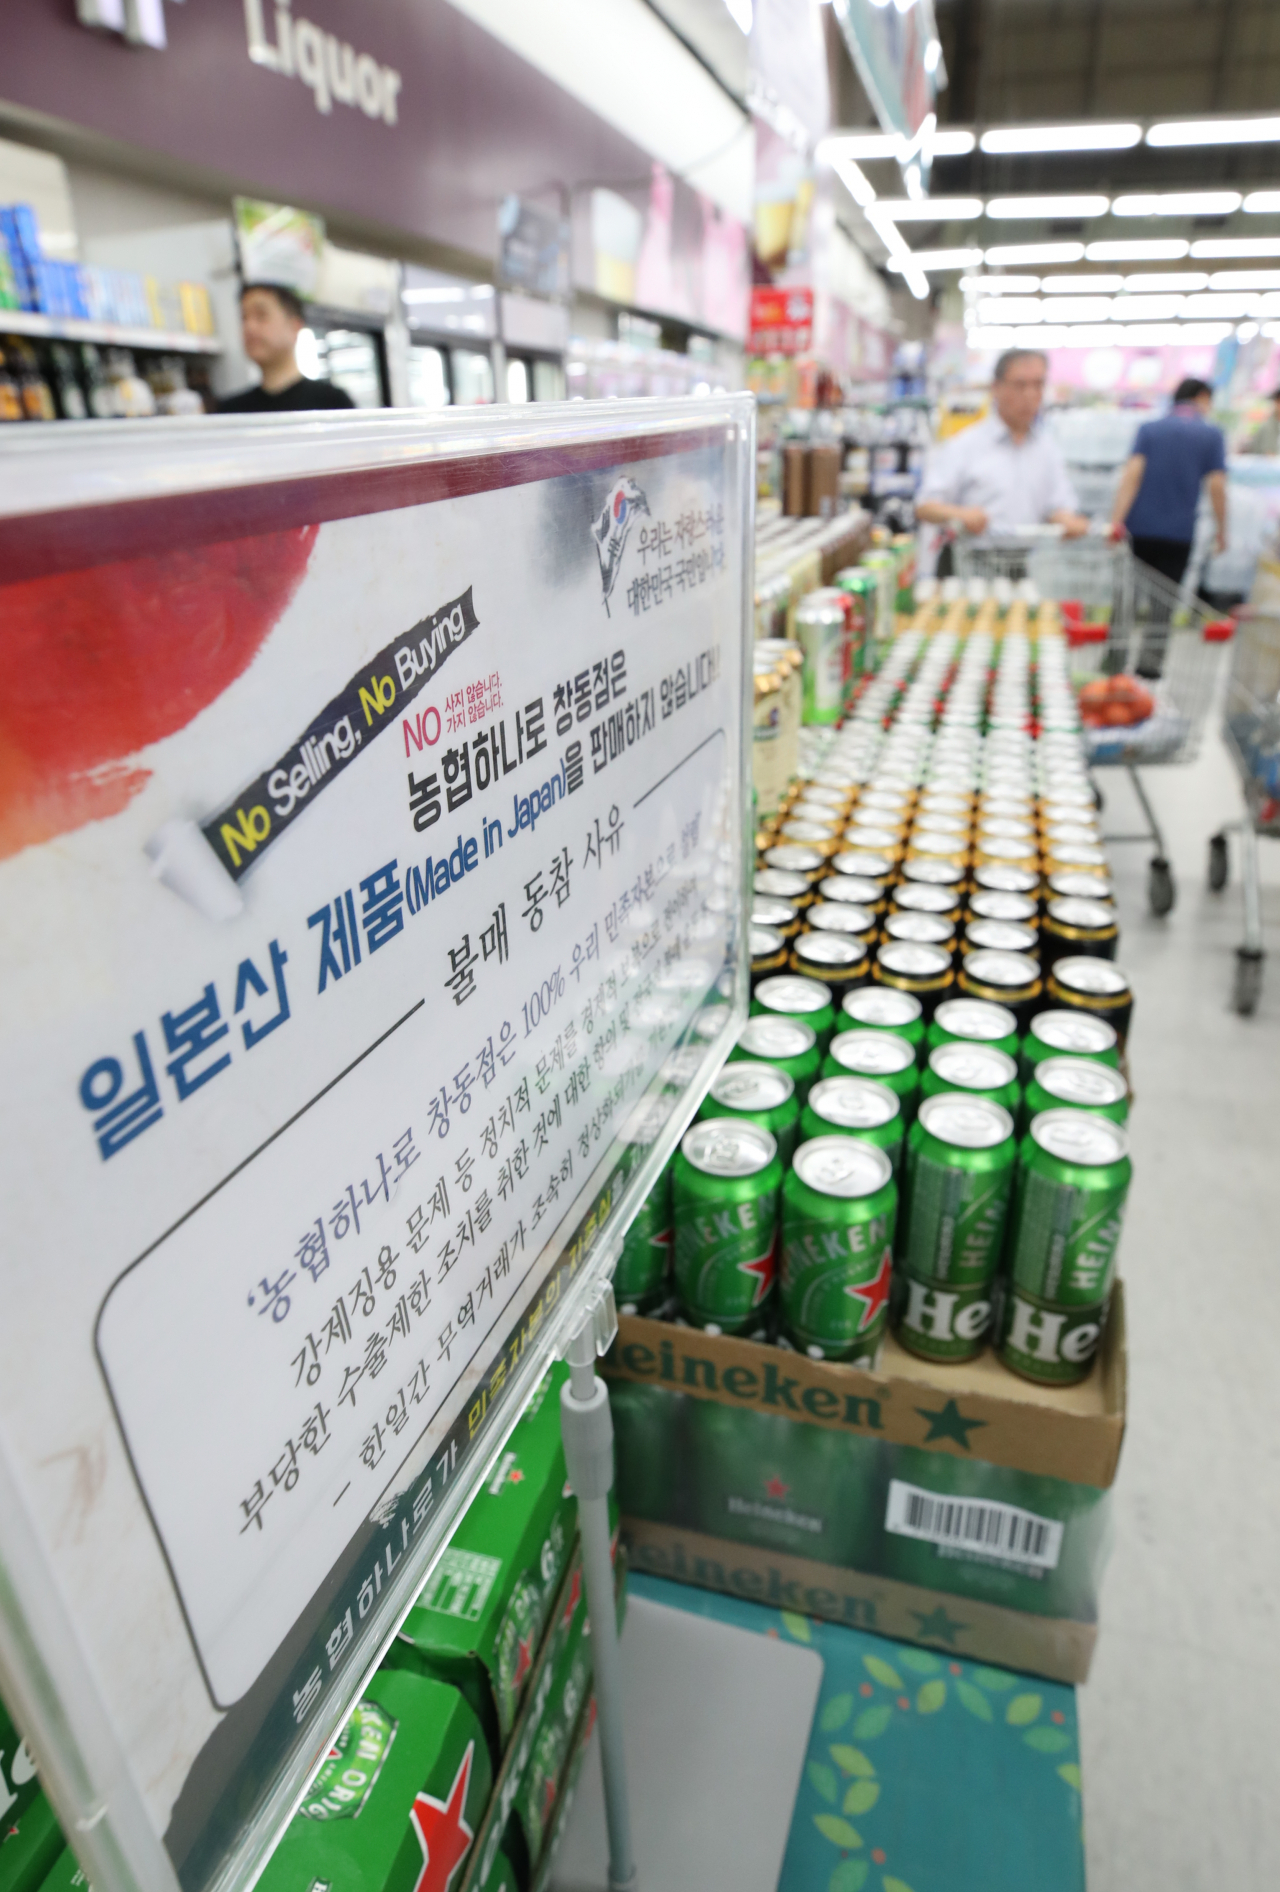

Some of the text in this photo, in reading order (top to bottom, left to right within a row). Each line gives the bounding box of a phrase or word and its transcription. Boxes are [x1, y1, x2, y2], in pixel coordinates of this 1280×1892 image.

[243, 0, 402, 126] Liquor
[627, 565, 673, 617] 대한민국
[637, 521, 673, 566] 우리는
[220, 604, 465, 867] No Selling, No Buying
[402, 706, 442, 758] NO
[407, 649, 627, 833] 농협하나로 창동점은
[444, 688, 465, 713] 사지
[446, 709, 467, 733] 가지
[78, 937, 291, 1162] 일본산
[482, 816, 503, 859] in
[590, 687, 655, 775] 판매하지
[444, 902, 509, 1006] 불매
[521, 846, 574, 933] 동참
[583, 804, 625, 870] 사유
[427, 1020, 517, 1139] 창동점은
[521, 964, 566, 1039] 100%
[570, 922, 600, 983] 우리
[239, 1402, 332, 1535] 부당한
[337, 1269, 431, 1408] 수출제한
[437, 1188, 493, 1285] 조치를
[497, 1138, 530, 1201] 취한
[532, 1093, 562, 1158] 것에
[564, 1055, 591, 1107] 대한
[290, 1245, 400, 1388] 강제징용
[406, 1175, 451, 1254] 문제
[454, 1147, 476, 1193] 등
[480, 1076, 531, 1159] 정치적
[534, 1020, 578, 1095] 문제를
[359, 1046, 645, 1471] 한일간 무역거래가 조속히 정상화되기
[467, 1269, 561, 1441] 민족자본의
